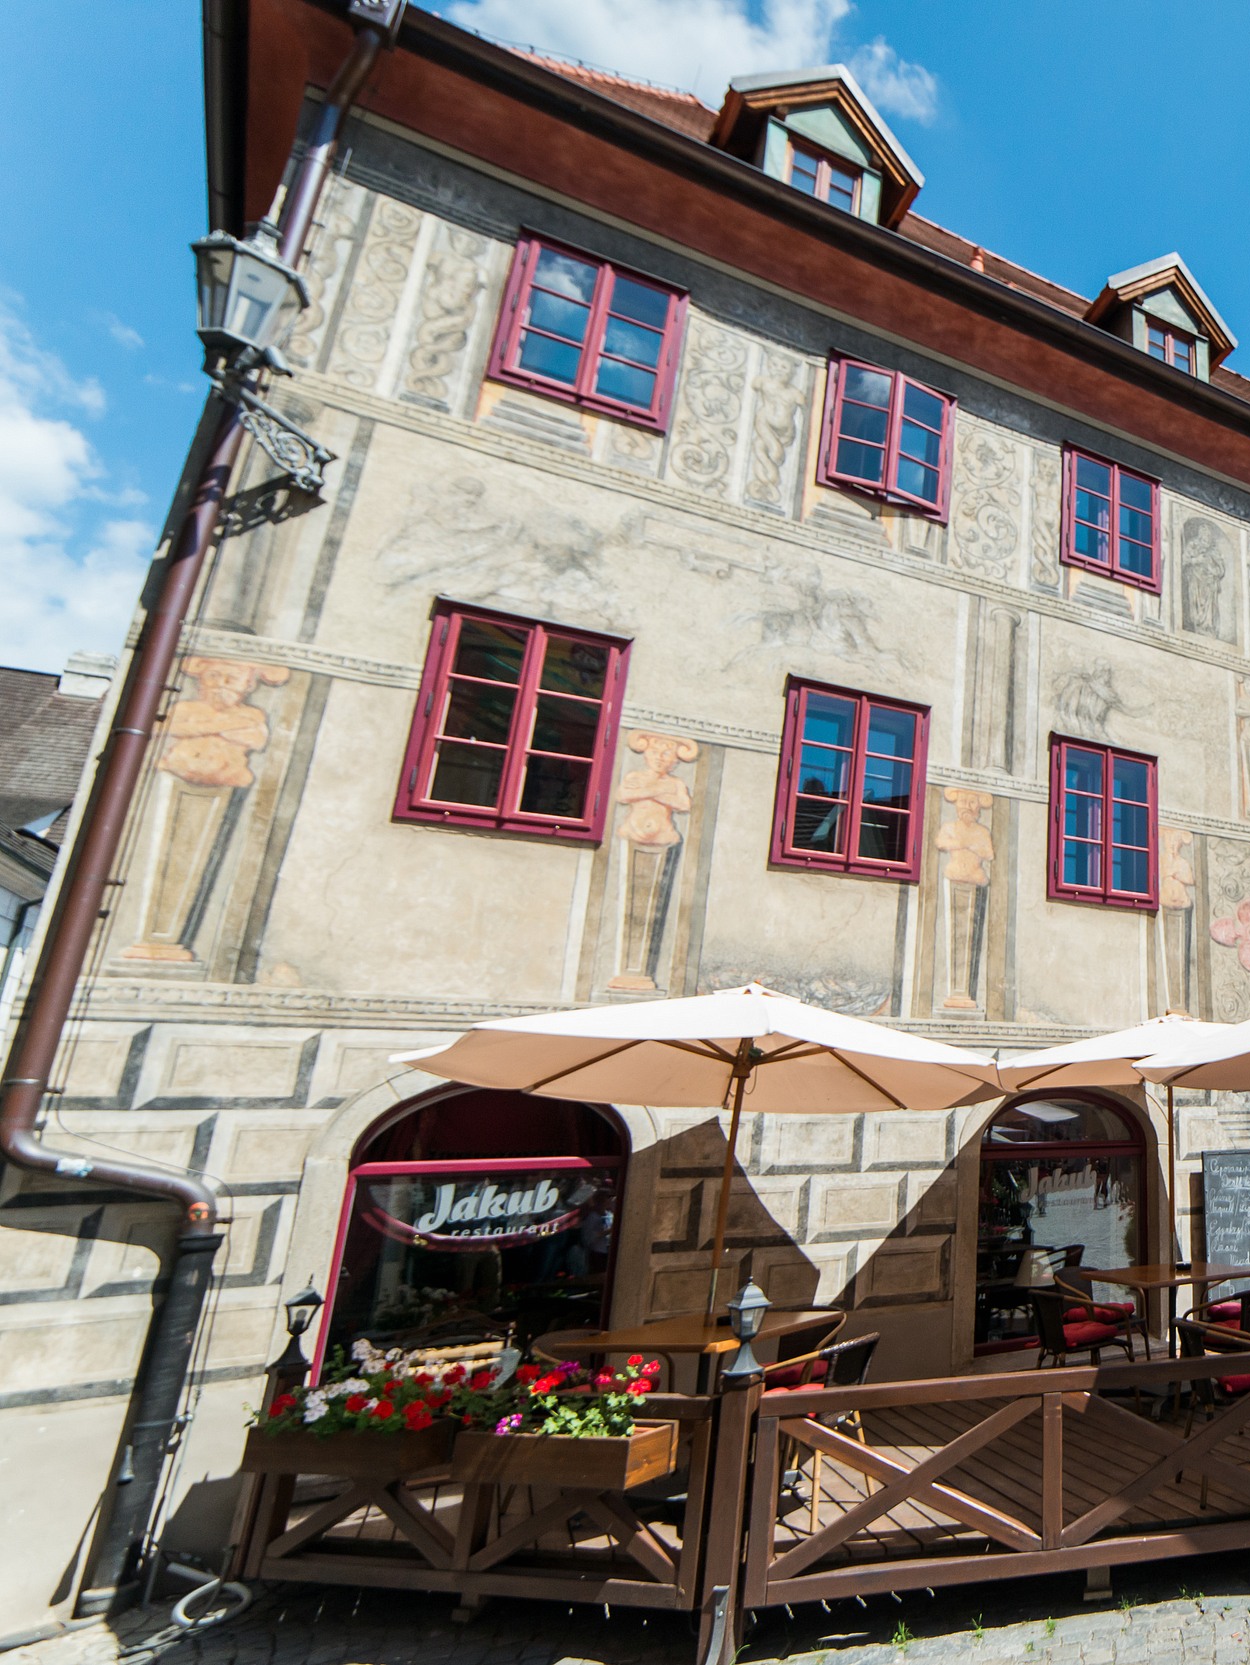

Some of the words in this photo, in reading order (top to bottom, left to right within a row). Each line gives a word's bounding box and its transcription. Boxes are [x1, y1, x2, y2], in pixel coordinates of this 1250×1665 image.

[1019, 1163, 1098, 1203] Jakub
[414, 1179, 560, 1233] Jakub
[450, 1221, 560, 1238] restaurant
